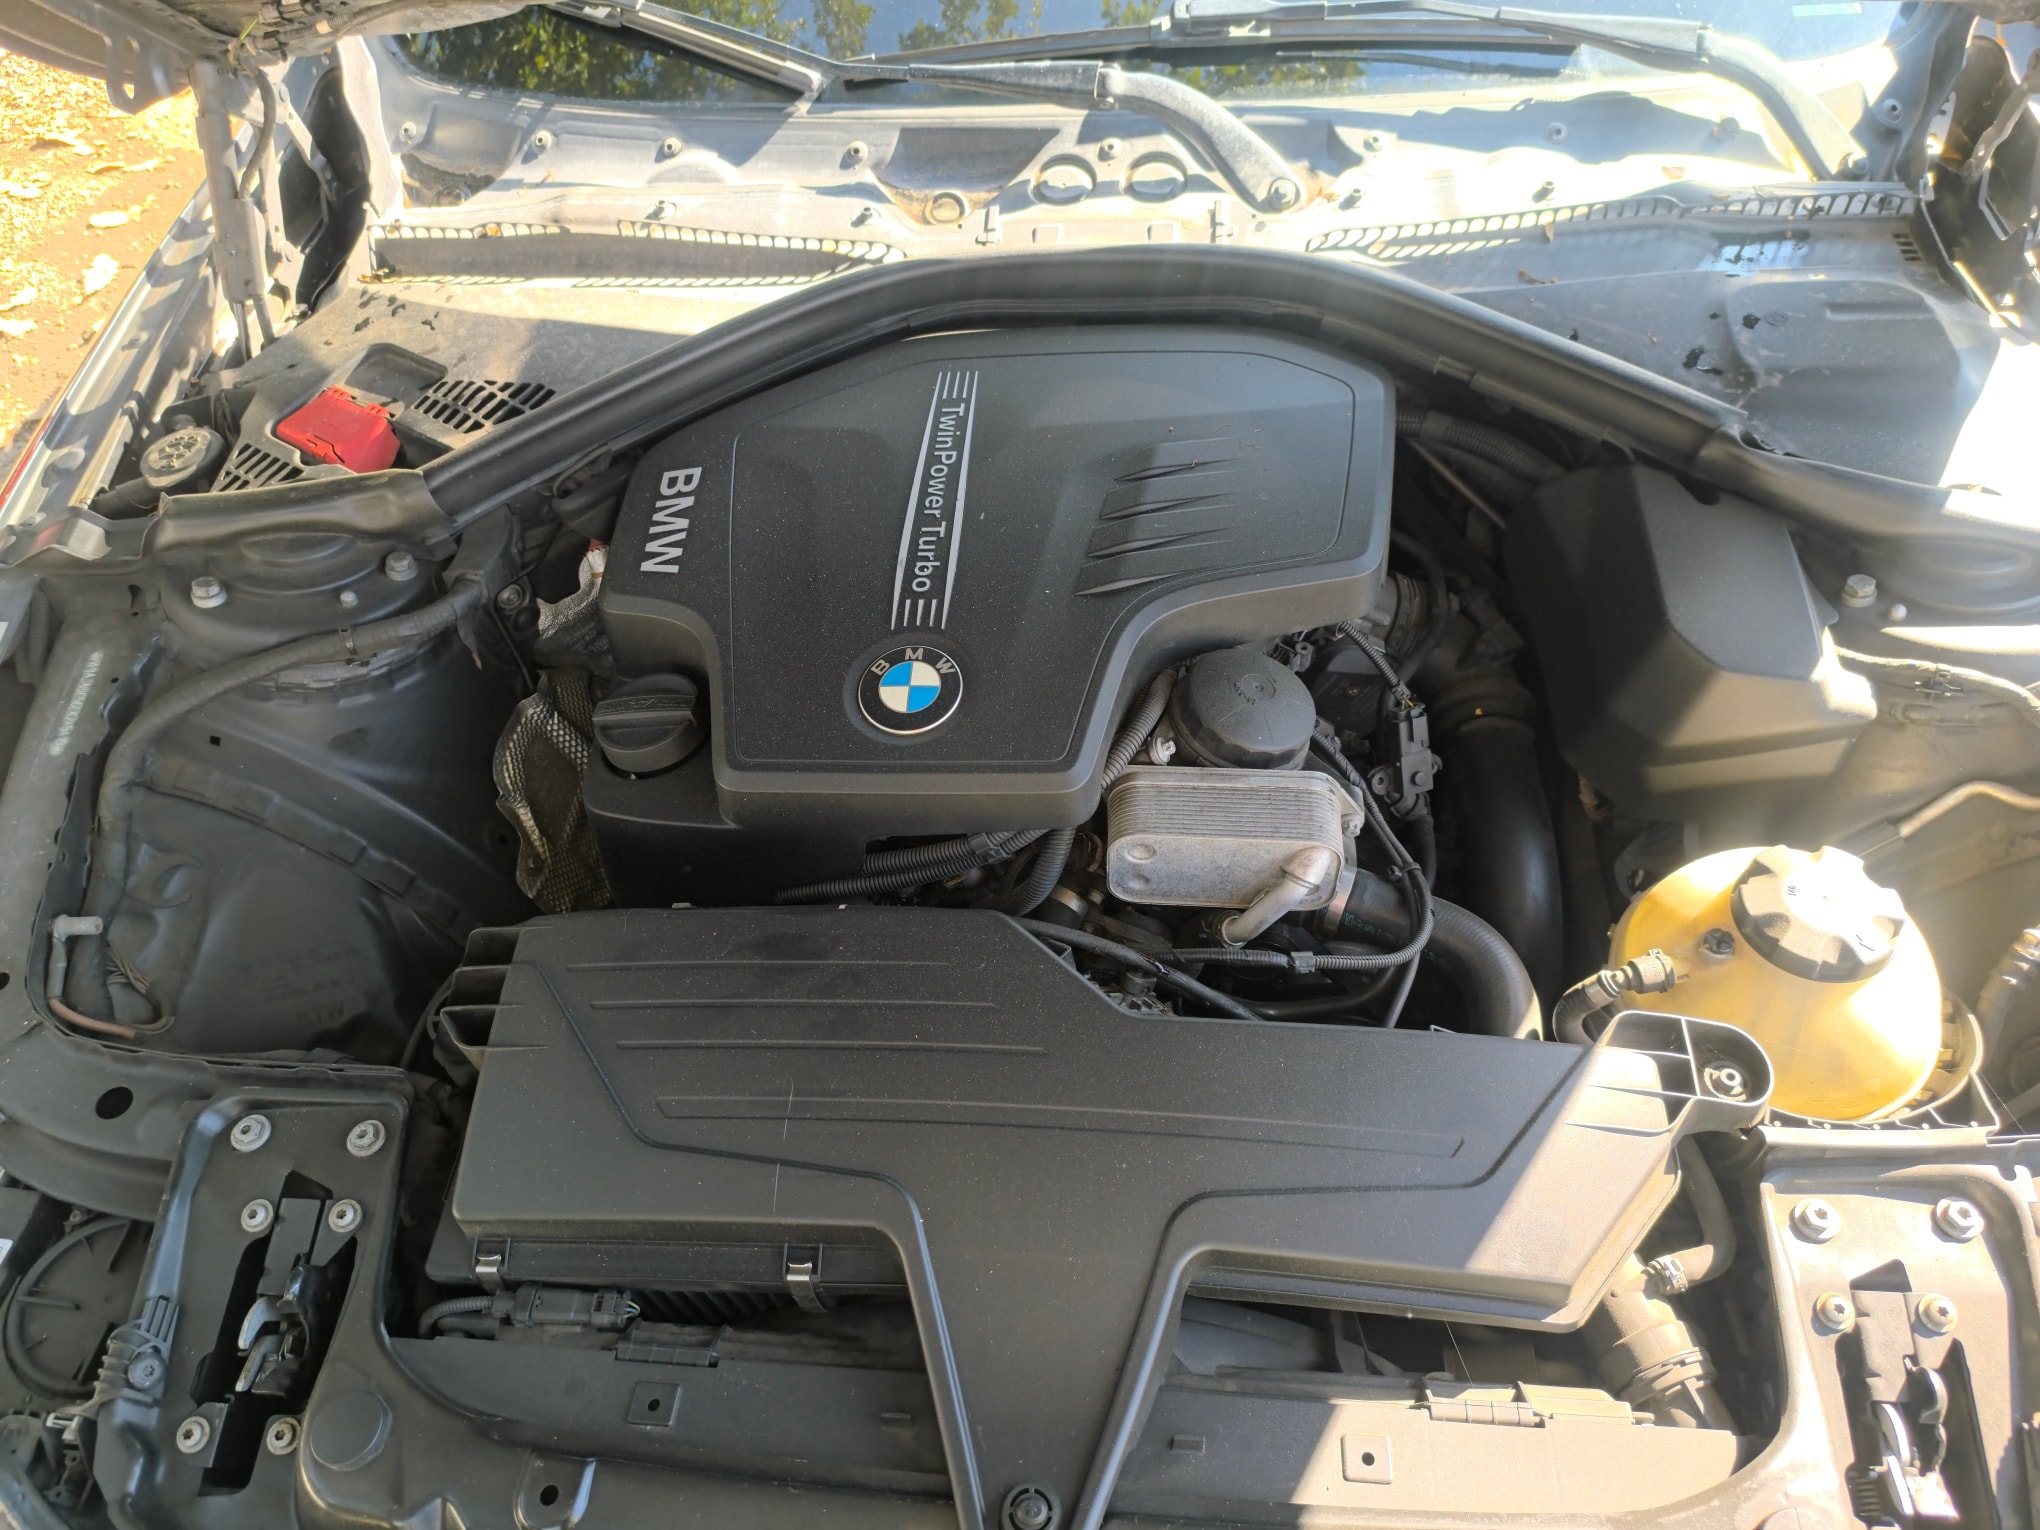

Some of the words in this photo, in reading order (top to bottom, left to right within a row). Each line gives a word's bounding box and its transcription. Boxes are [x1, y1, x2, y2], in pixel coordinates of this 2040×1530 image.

[925, 403, 965, 517] TwinPower
[641, 467, 702, 573] BMW
[913, 521, 945, 592] Turbo
[871, 648, 955, 675] BMW
